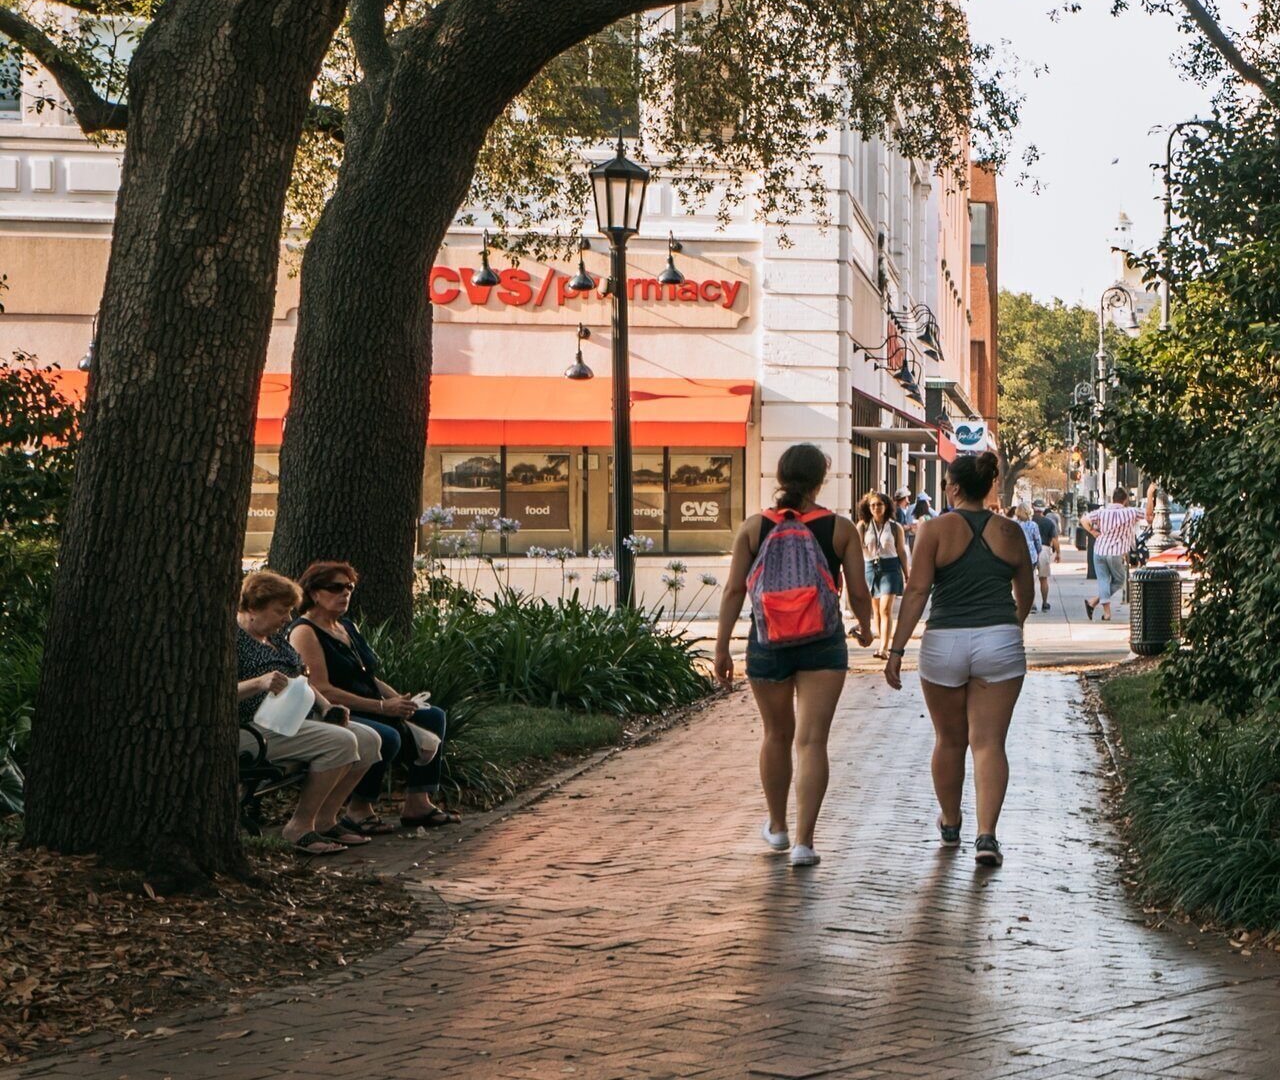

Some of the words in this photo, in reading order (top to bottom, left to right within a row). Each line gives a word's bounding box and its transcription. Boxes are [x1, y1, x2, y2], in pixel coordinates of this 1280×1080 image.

[430, 266, 740, 308] CVS/prmacy
[247, 507, 275, 517] hoto
[453, 506, 500, 517] harmacy
[525, 505, 550, 515] food
[633, 508, 664, 518] erage
[680, 501, 719, 516] CVS
[681, 515, 718, 523] pharmacy
